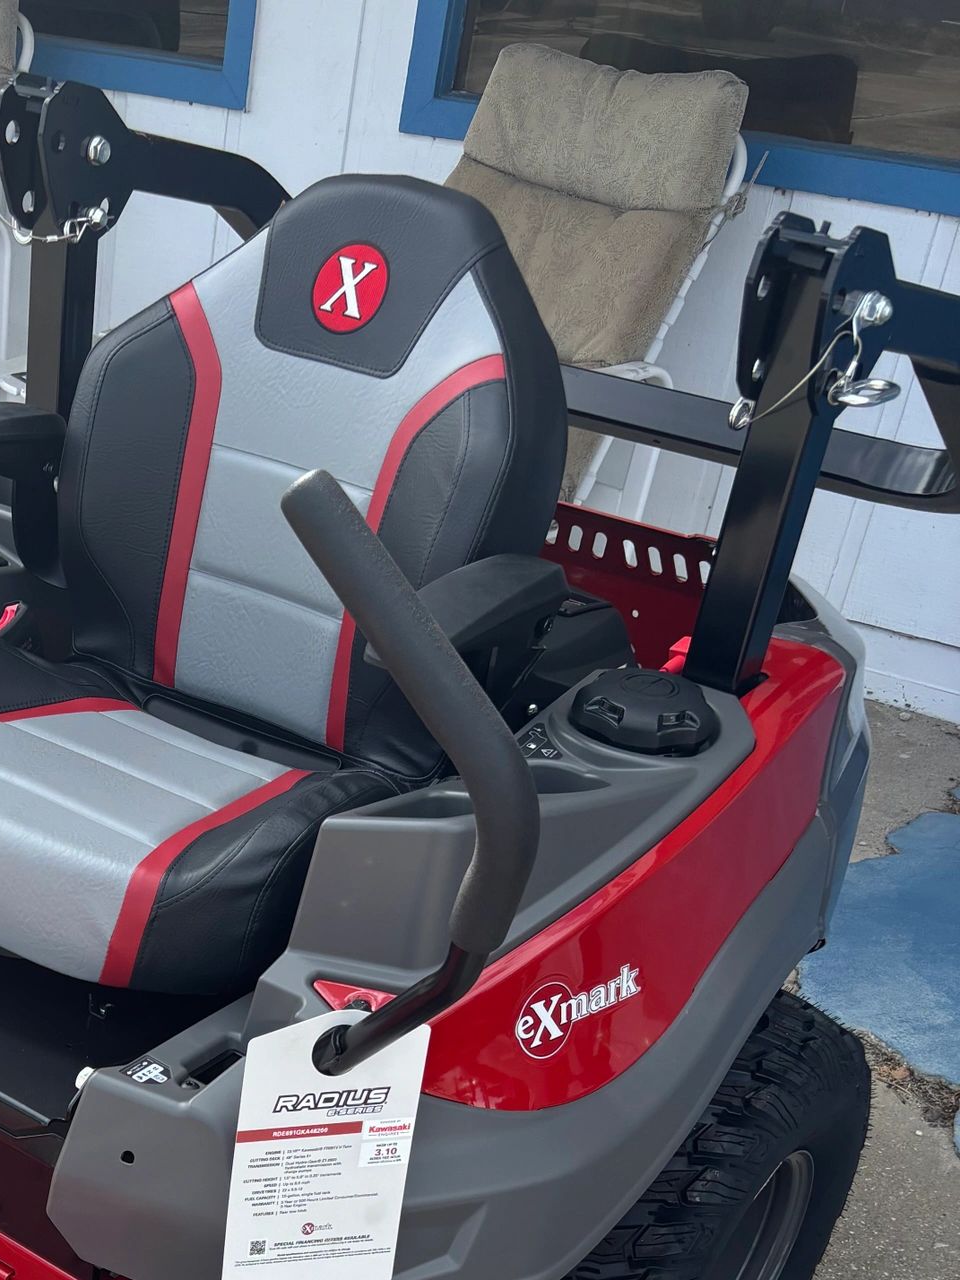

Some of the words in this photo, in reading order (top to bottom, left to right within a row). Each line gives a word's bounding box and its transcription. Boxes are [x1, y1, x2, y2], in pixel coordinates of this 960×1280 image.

[320, 256, 377, 320] X
[517, 964, 640, 1048] eXmark
[272, 1086, 390, 1113] RADIUS
[368, 1122, 411, 1133] Kawasaki
[374, 1147, 397, 1156] 3.10
